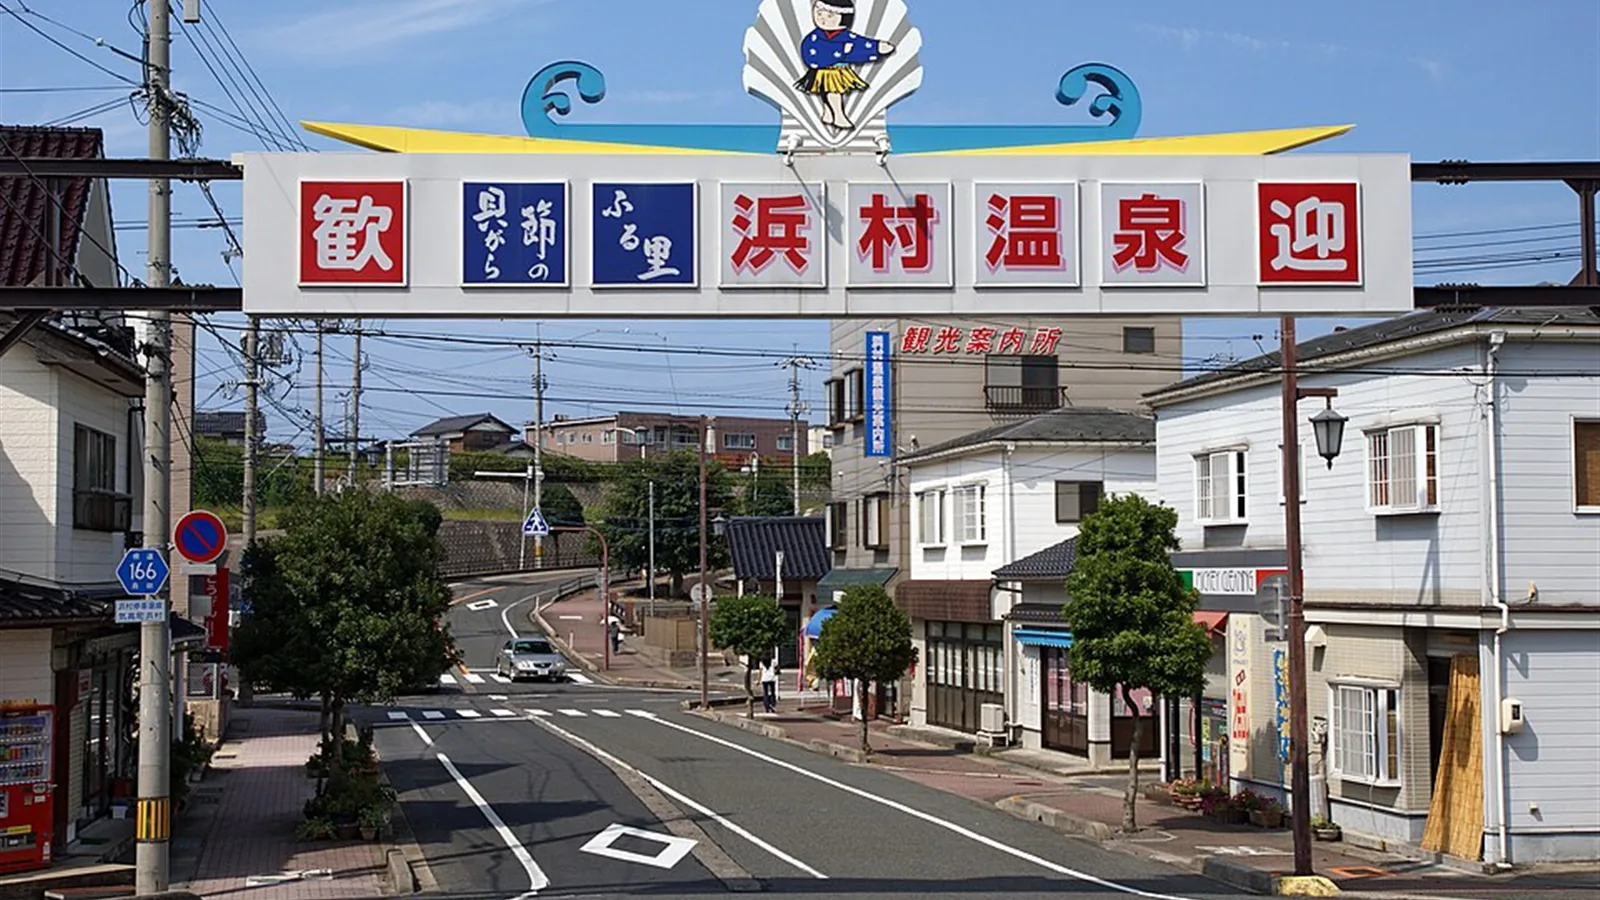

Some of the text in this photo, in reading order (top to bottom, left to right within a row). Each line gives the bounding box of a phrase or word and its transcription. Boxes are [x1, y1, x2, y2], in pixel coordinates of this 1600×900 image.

[312, 194, 393, 272] 歓
[472, 187, 509, 280] 貝がら
[520, 199, 557, 280] 節の
[602, 190, 681, 280] ふる里
[732, 193, 1190, 274] 浜村温泉
[1269, 197, 1348, 273] 迎
[901, 326, 1063, 355] 観光案内所
[130, 562, 157, 580] 166
